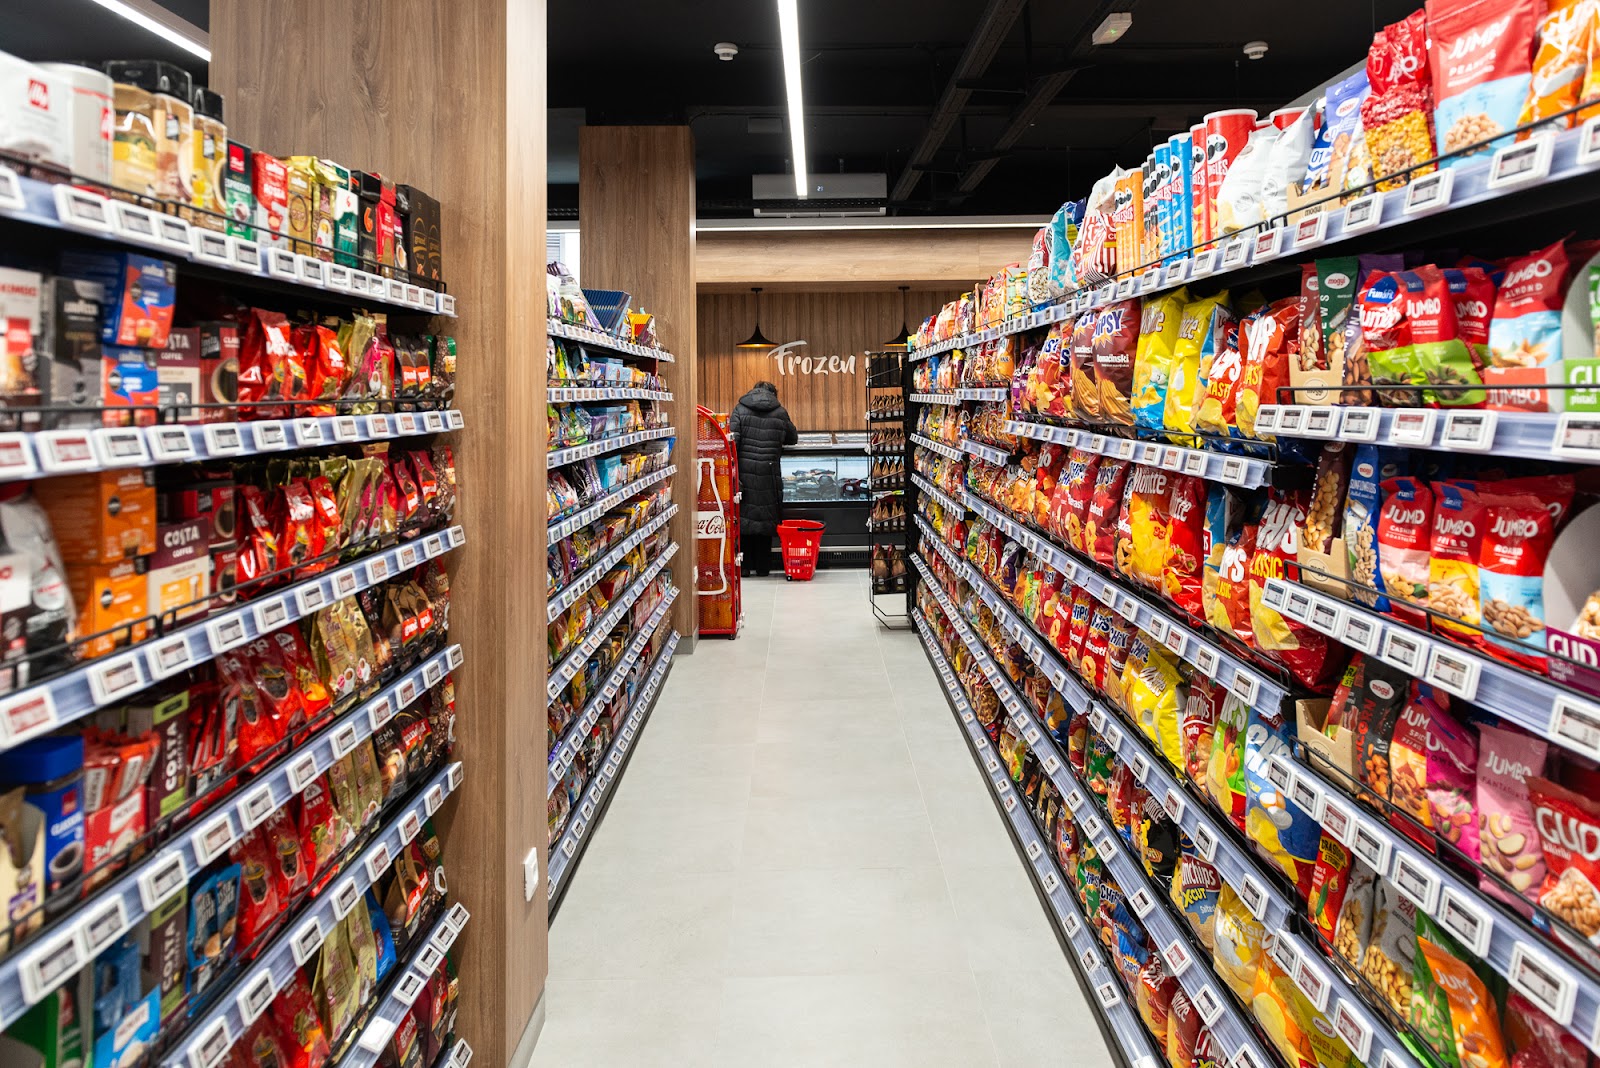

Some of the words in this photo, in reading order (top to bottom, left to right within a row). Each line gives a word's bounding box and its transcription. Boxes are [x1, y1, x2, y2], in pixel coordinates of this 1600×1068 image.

[1501, 259, 1553, 288] JUMBO
[1406, 297, 1441, 318] JUMBO
[1454, 300, 1488, 318] JUMBO
[160, 352, 184, 361] COFFEE
[766, 340, 856, 376] Frozen
[1489, 386, 1541, 407] JUMBO
[164, 526, 200, 548] COSTA
[1434, 513, 1476, 538] JUMBO
[1491, 515, 1539, 538] JUMBO
[172, 547, 195, 559] COFFEE
[1400, 705, 1431, 730] JUM
[166, 721, 179, 791] COSTA
[162, 921, 177, 991] COSTA
